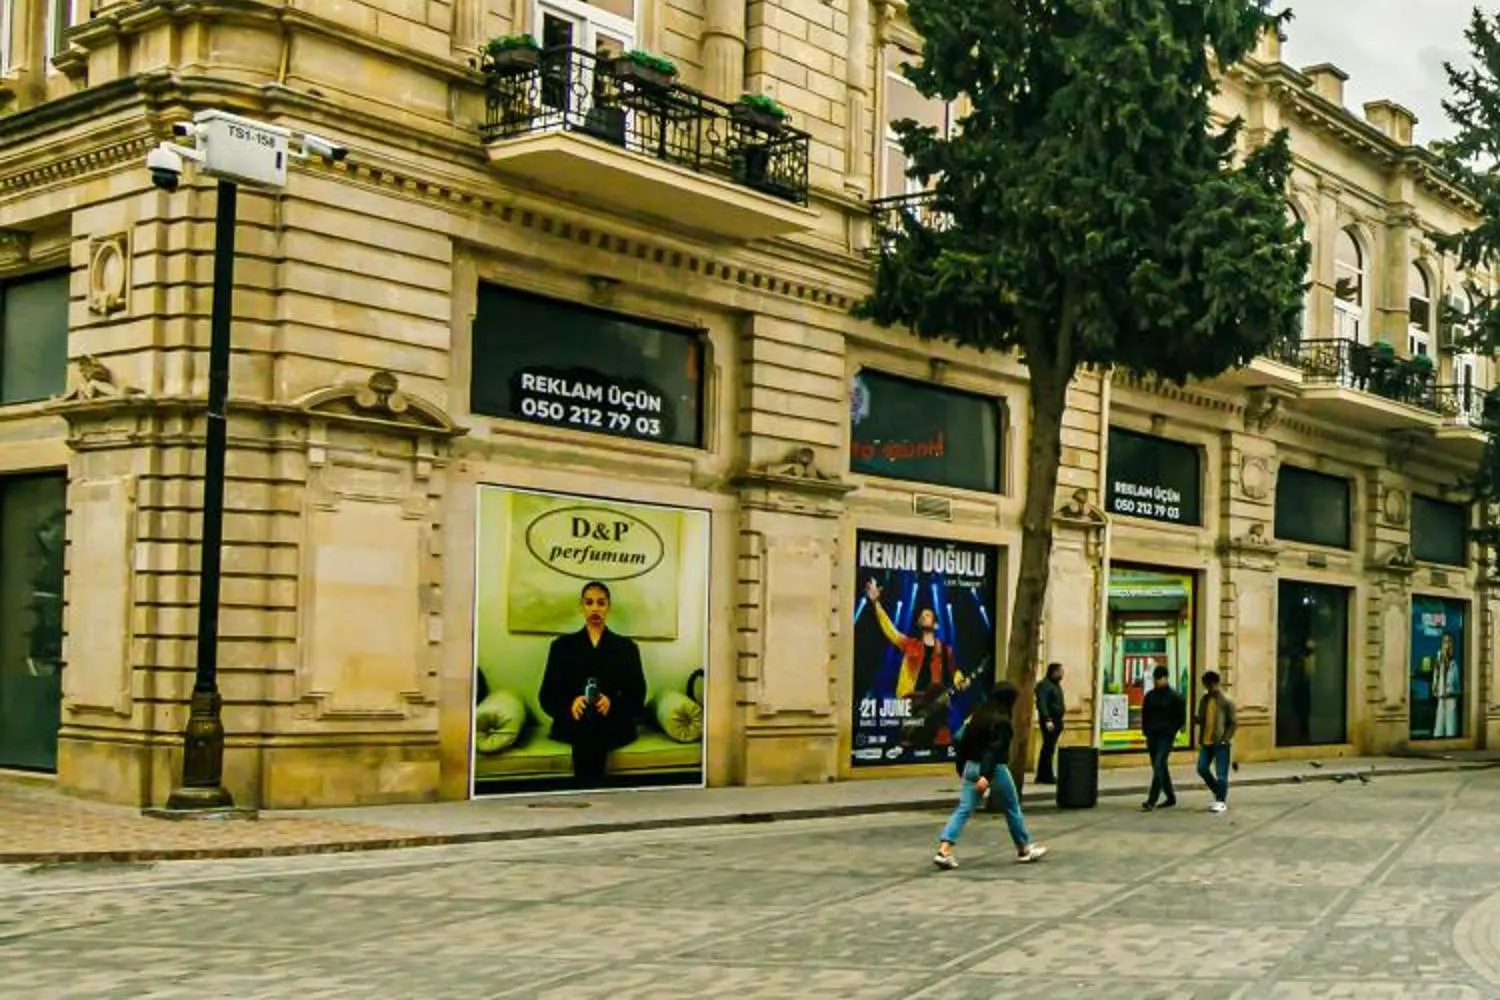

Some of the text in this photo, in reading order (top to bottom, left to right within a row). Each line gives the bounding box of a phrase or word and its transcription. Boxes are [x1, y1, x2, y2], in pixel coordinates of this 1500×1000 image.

[521, 373, 661, 412] REKLAM ÜÇÜN
[521, 398, 661, 435] 050 212 79 03
[1114, 481, 1153, 498] REKLAM
[1114, 497, 1135, 513] 050
[1136, 501, 1153, 515] 212
[571, 516, 629, 542] D&P
[549, 544, 647, 566] perfumum
[860, 540, 985, 577] KENAN DOĞULU
[860, 697, 913, 718] 21 JUNE
